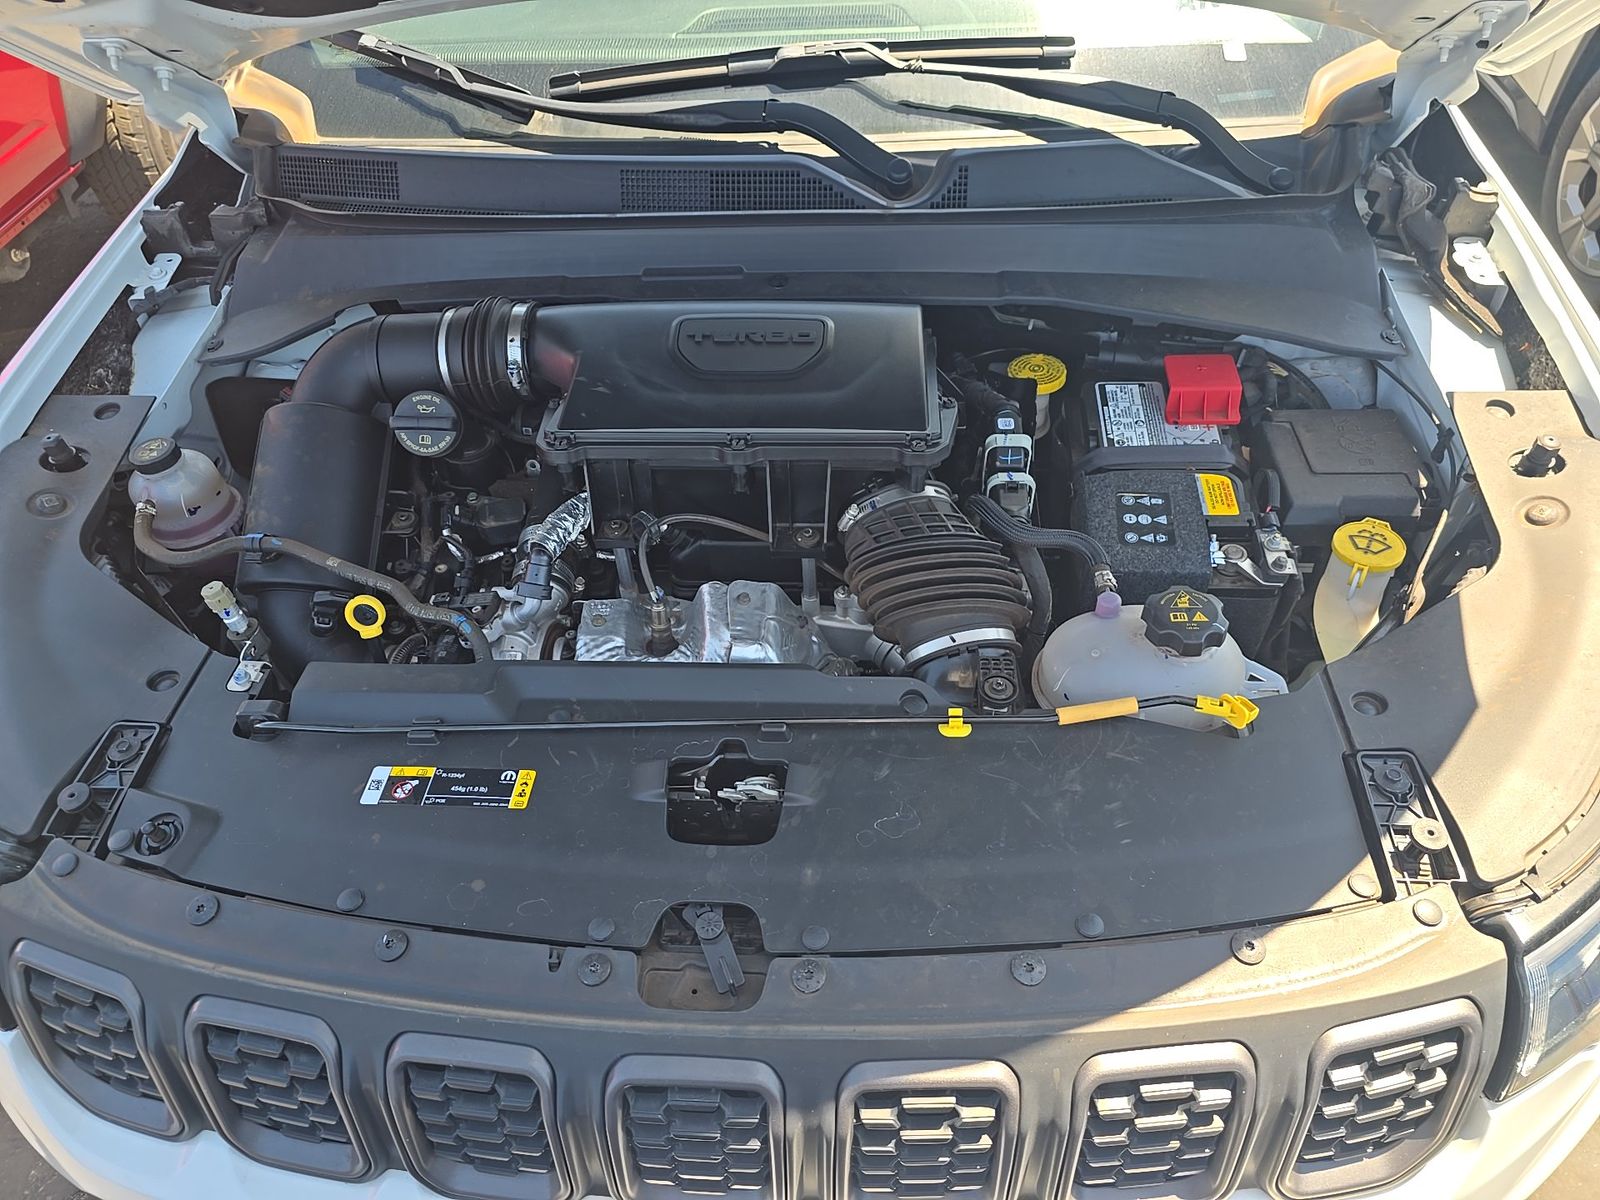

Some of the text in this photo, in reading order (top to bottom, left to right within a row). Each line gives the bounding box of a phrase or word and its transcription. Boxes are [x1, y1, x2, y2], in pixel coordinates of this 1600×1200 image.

[686, 330, 816, 343] TURBO
[412, 394, 441, 405] ENGINE OIL
[400, 432, 408, 442] API
